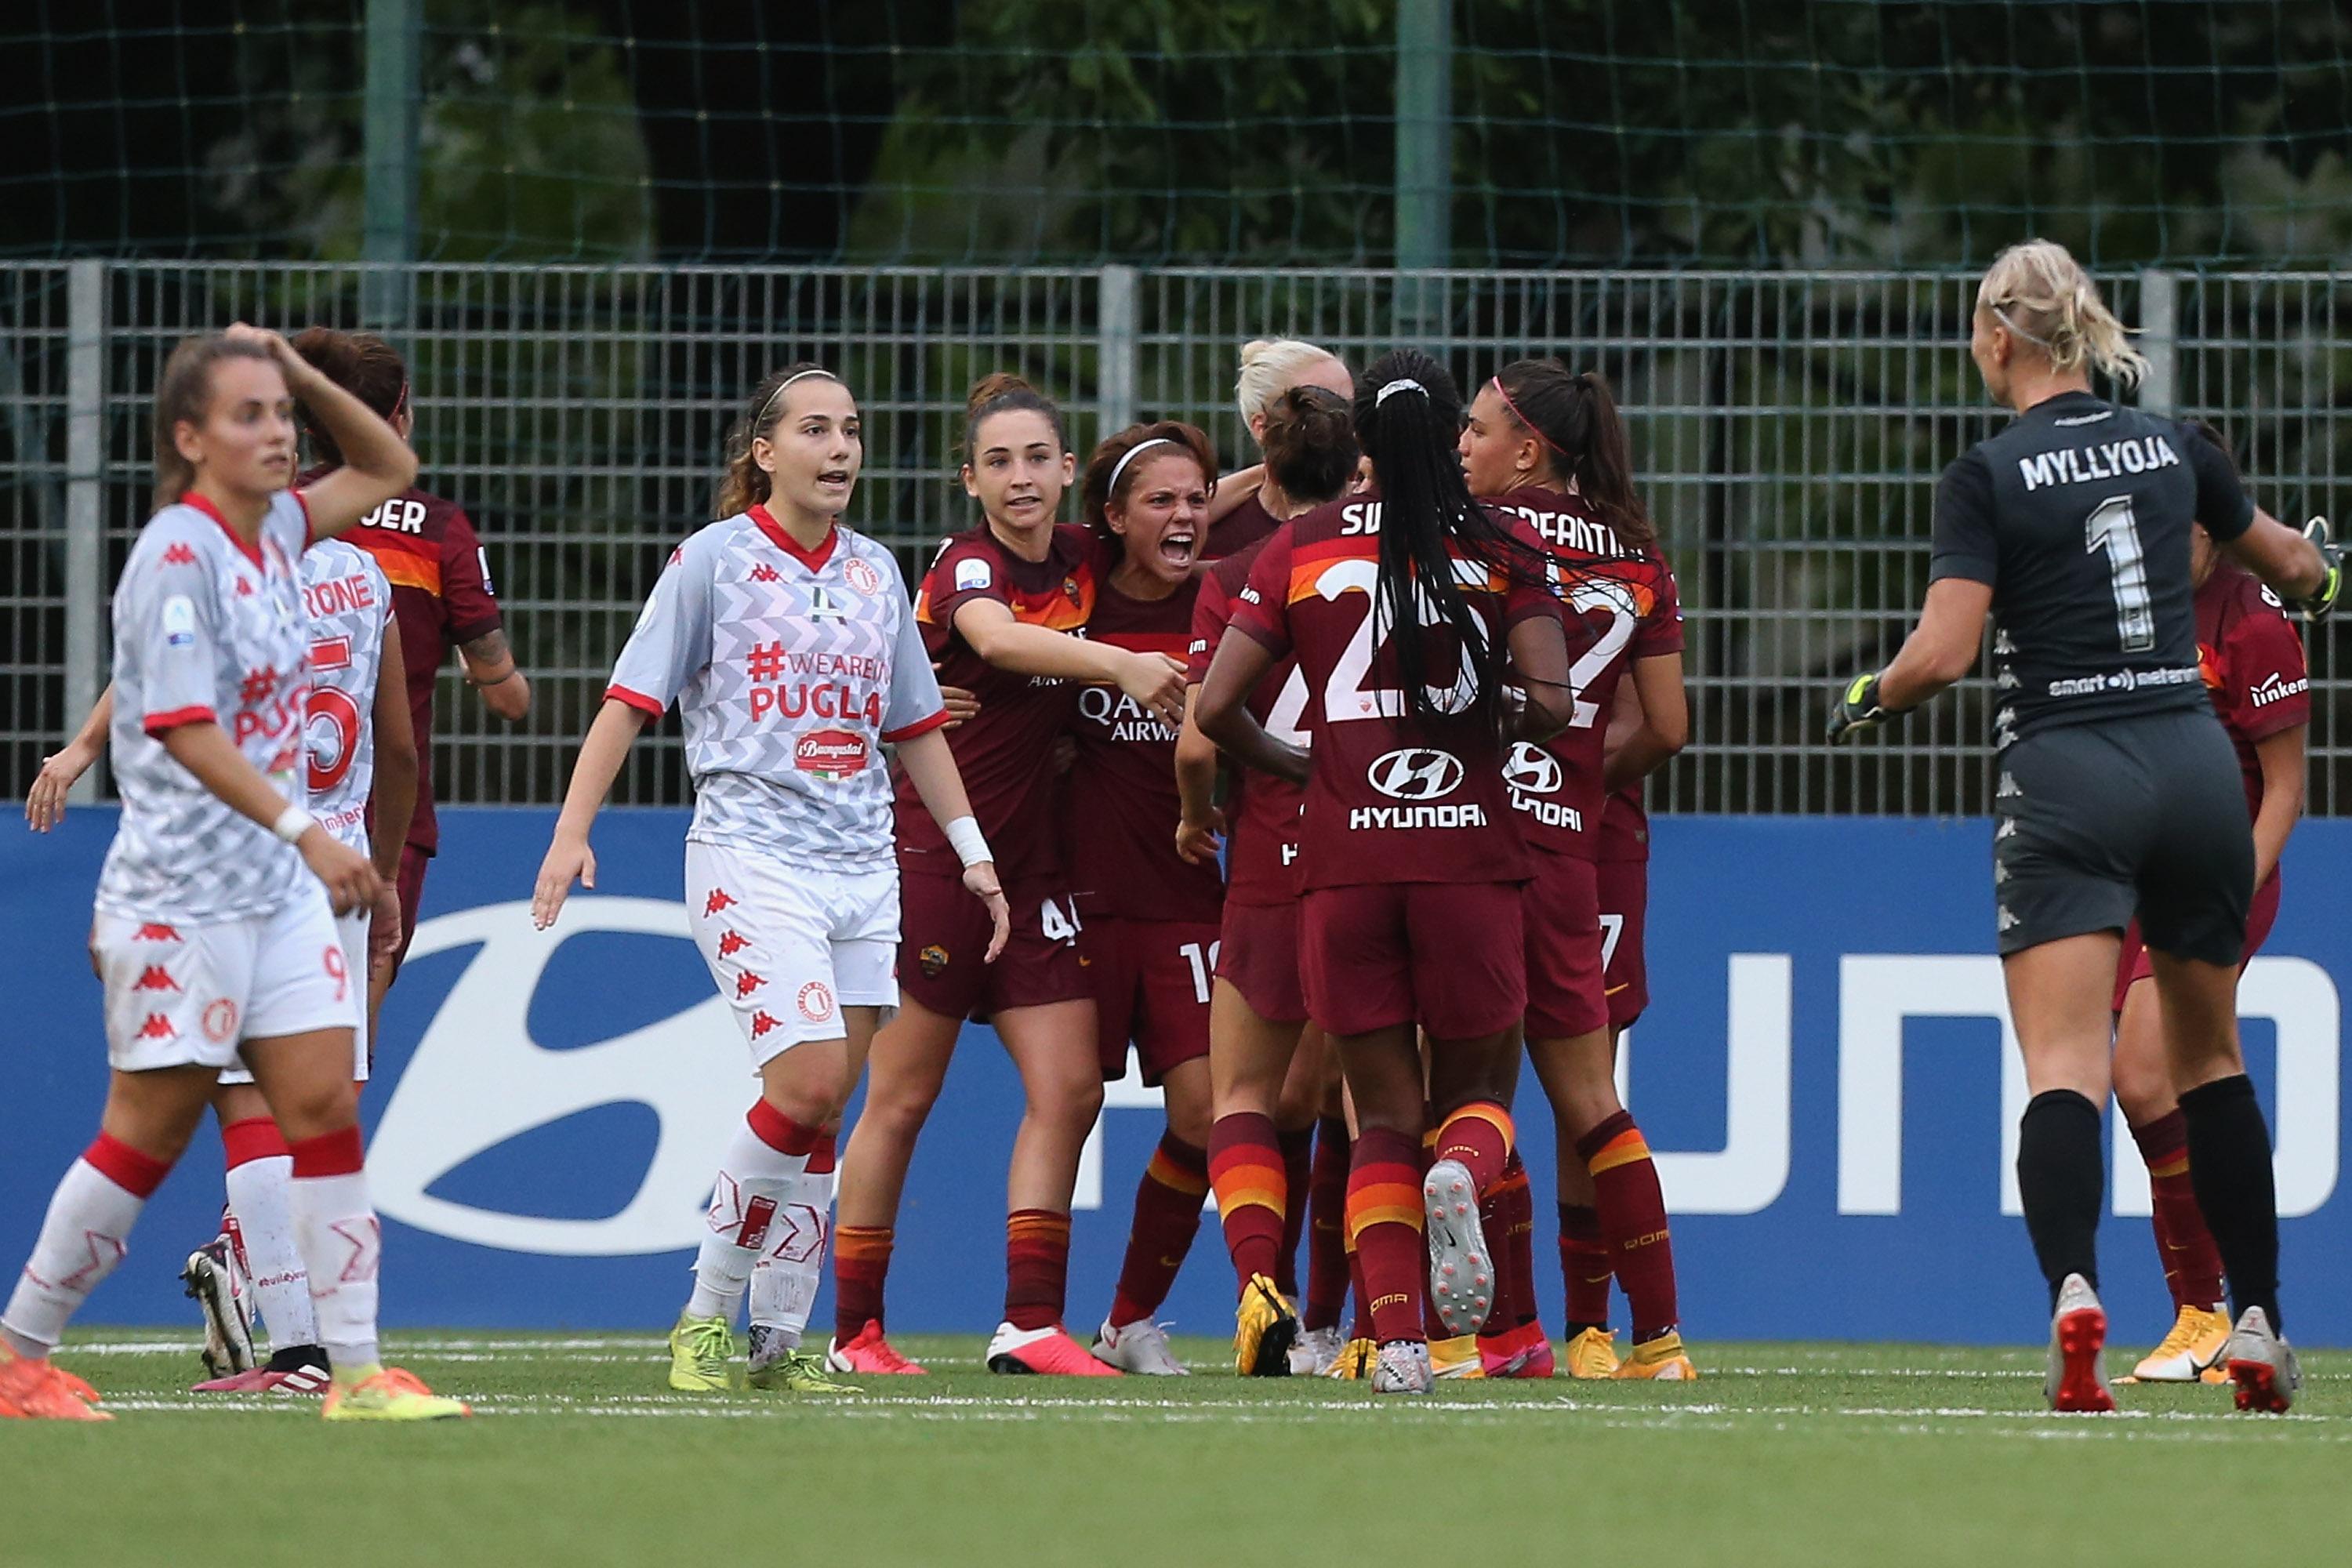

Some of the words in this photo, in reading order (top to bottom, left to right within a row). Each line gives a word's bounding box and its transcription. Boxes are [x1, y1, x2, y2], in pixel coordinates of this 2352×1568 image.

[2019, 435, 2180, 491] MYLLYOJA
[2085, 495, 2154, 653] 1
[324, 946, 345, 1002] 9
